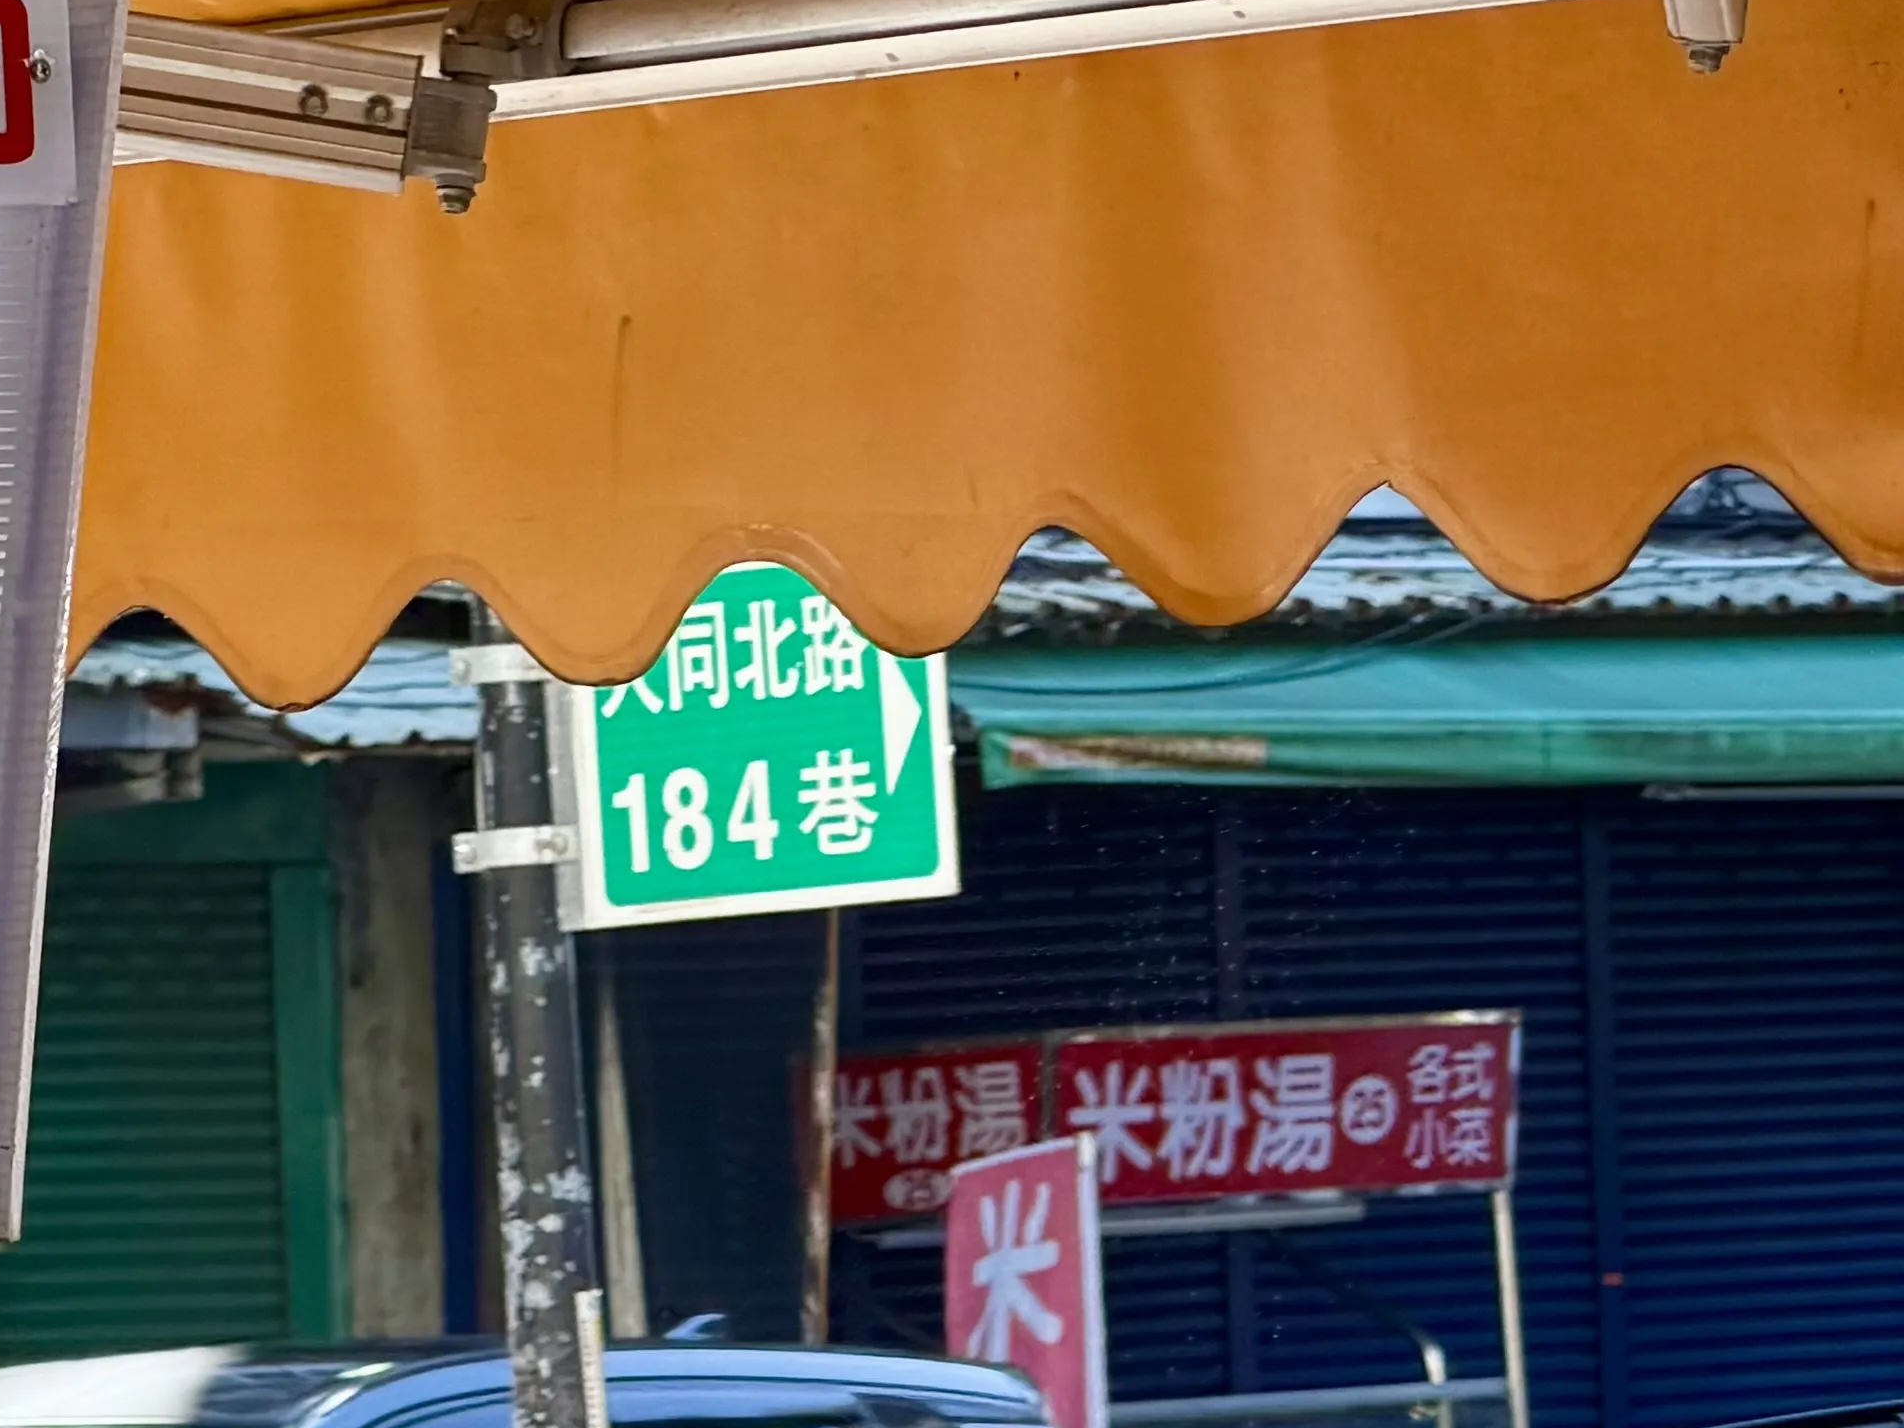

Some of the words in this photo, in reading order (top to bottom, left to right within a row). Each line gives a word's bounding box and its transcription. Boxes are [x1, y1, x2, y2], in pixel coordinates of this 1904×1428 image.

[1069, 1053, 1334, 1186] 米粉湯
[1406, 1043, 1496, 1109] 各式
[1404, 1109, 1495, 1172] 小菜
[966, 1178, 1066, 1363] 米
